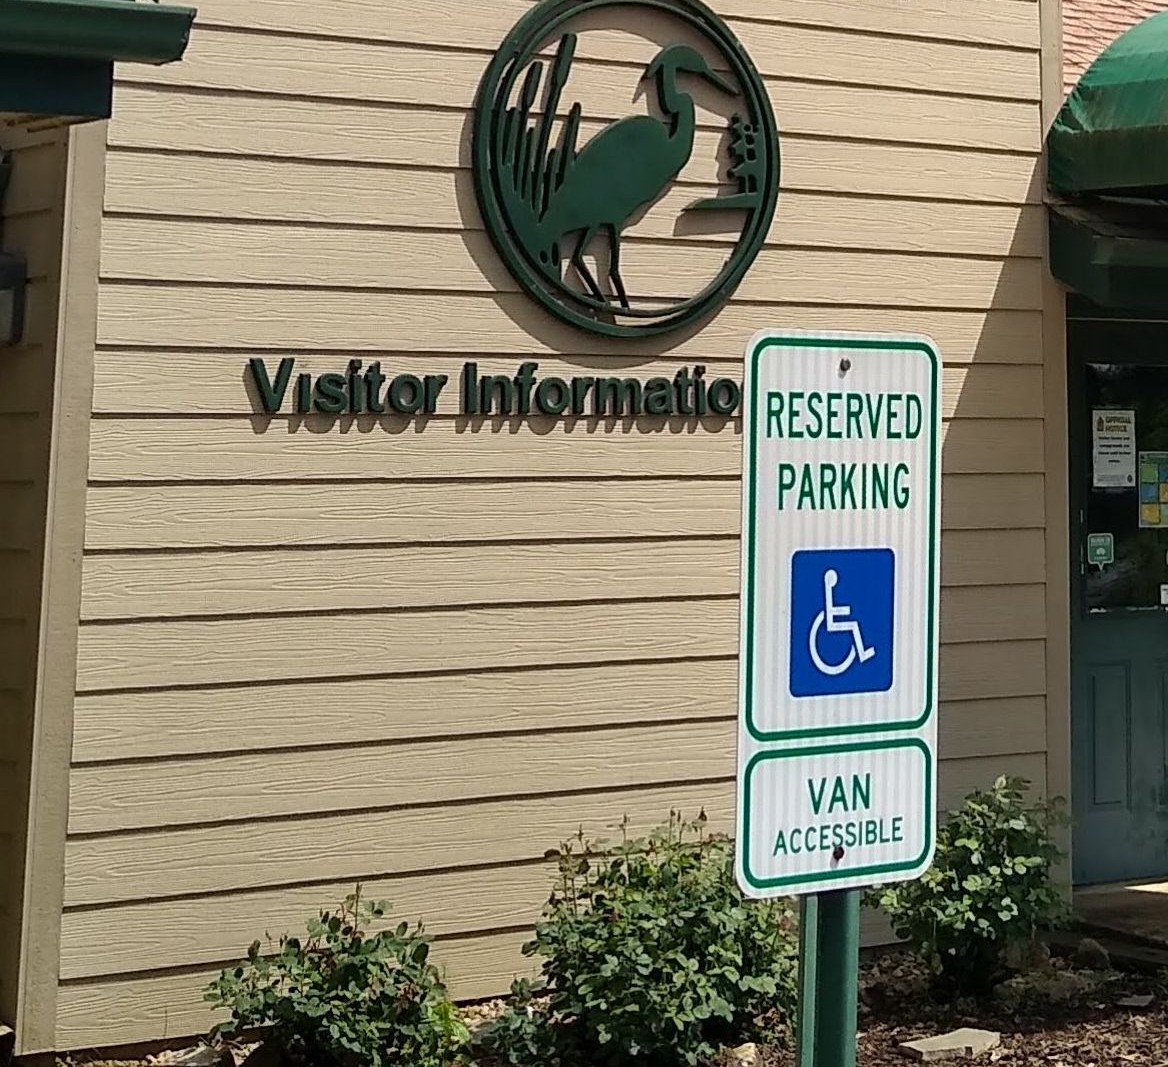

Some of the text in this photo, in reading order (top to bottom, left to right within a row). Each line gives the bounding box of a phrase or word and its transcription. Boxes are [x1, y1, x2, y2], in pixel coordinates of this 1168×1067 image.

[249, 357, 743, 416] Visitor Informatio
[766, 391, 923, 439] RESERVED
[778, 463, 911, 511] PARKING
[807, 773, 871, 815] VAN
[773, 817, 904, 856] ACCESSIBLE
